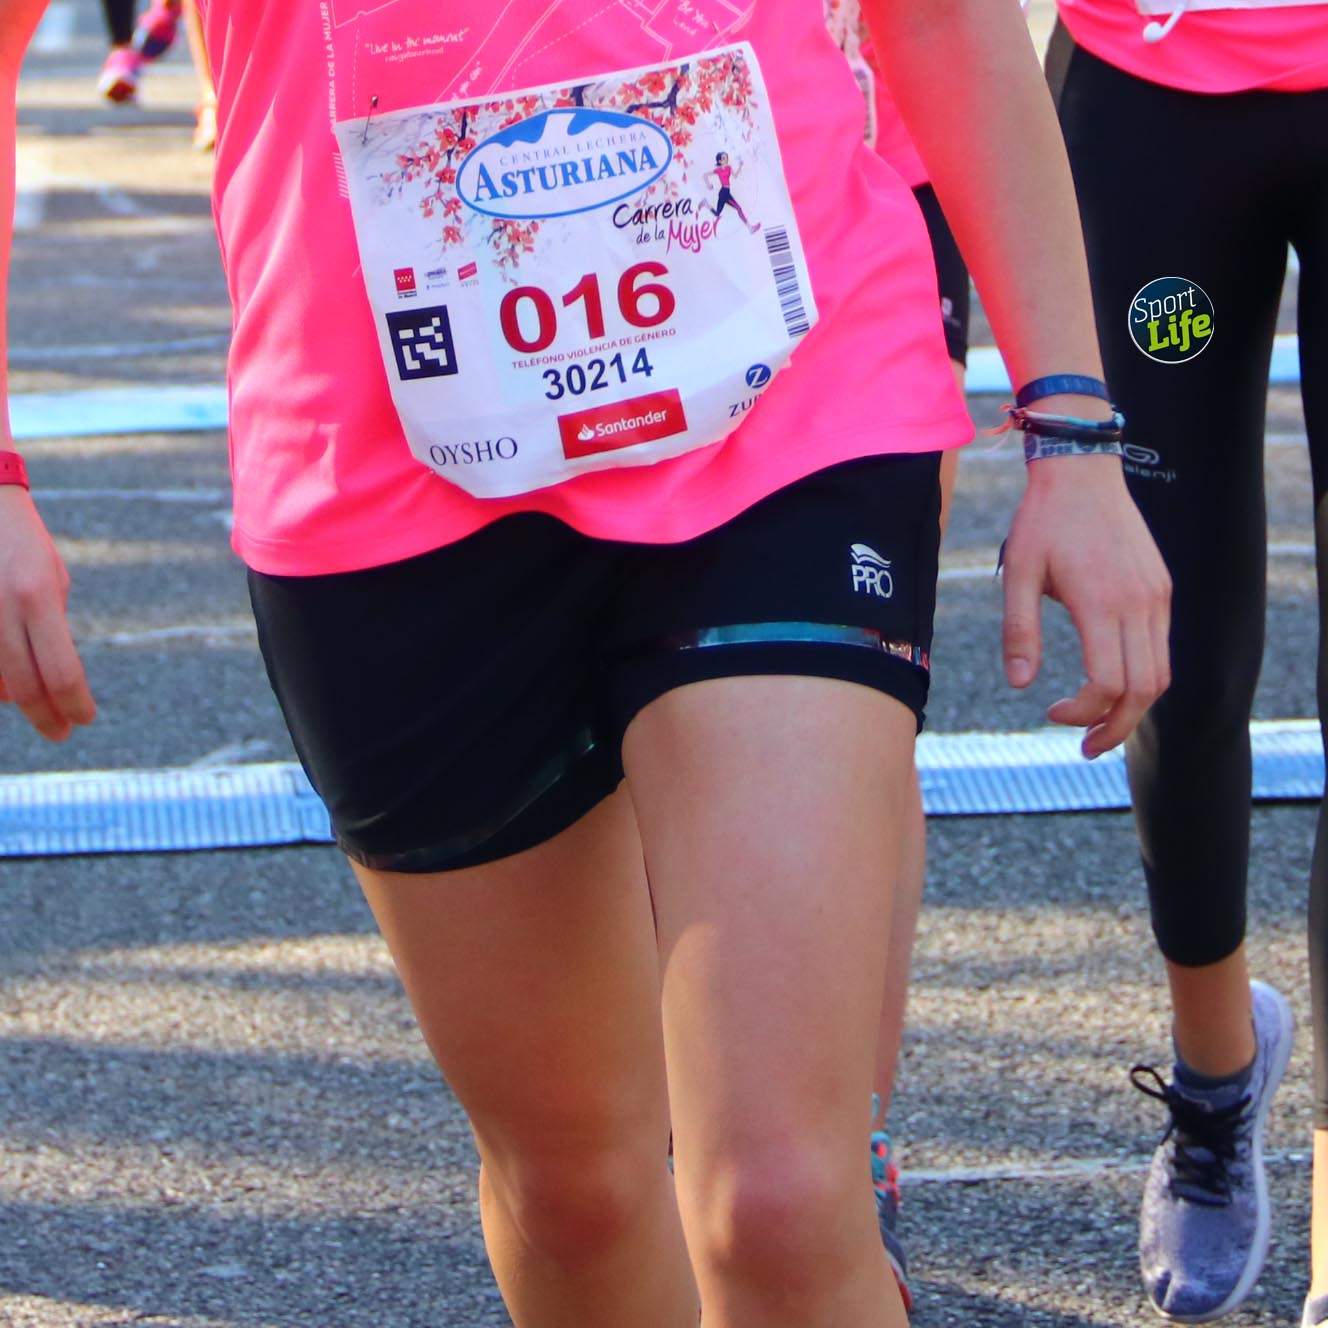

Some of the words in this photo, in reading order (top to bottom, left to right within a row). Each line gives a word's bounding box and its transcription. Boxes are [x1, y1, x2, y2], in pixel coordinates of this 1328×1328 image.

[319, 1, 333, 41] MUJER
[499, 145, 569, 169] CENTRAL
[576, 130, 648, 155] LECHERA
[473, 144, 659, 203] ASTURIANA
[612, 196, 694, 229] Carrera
[636, 228, 651, 246] de
[654, 225, 666, 241] la
[666, 218, 721, 254] Mujer
[499, 260, 677, 354] 016
[512, 354, 565, 369] TELÉFONO
[567, 341, 618, 359] VIOLENCIA
[619, 336, 632, 346] DE
[634, 328, 677, 344] GÉNERO
[542, 347, 654, 401] 30214
[594, 406, 669, 439] Santander
[429, 435, 519, 467] OYSHO
[851, 564, 893, 599] PRO
